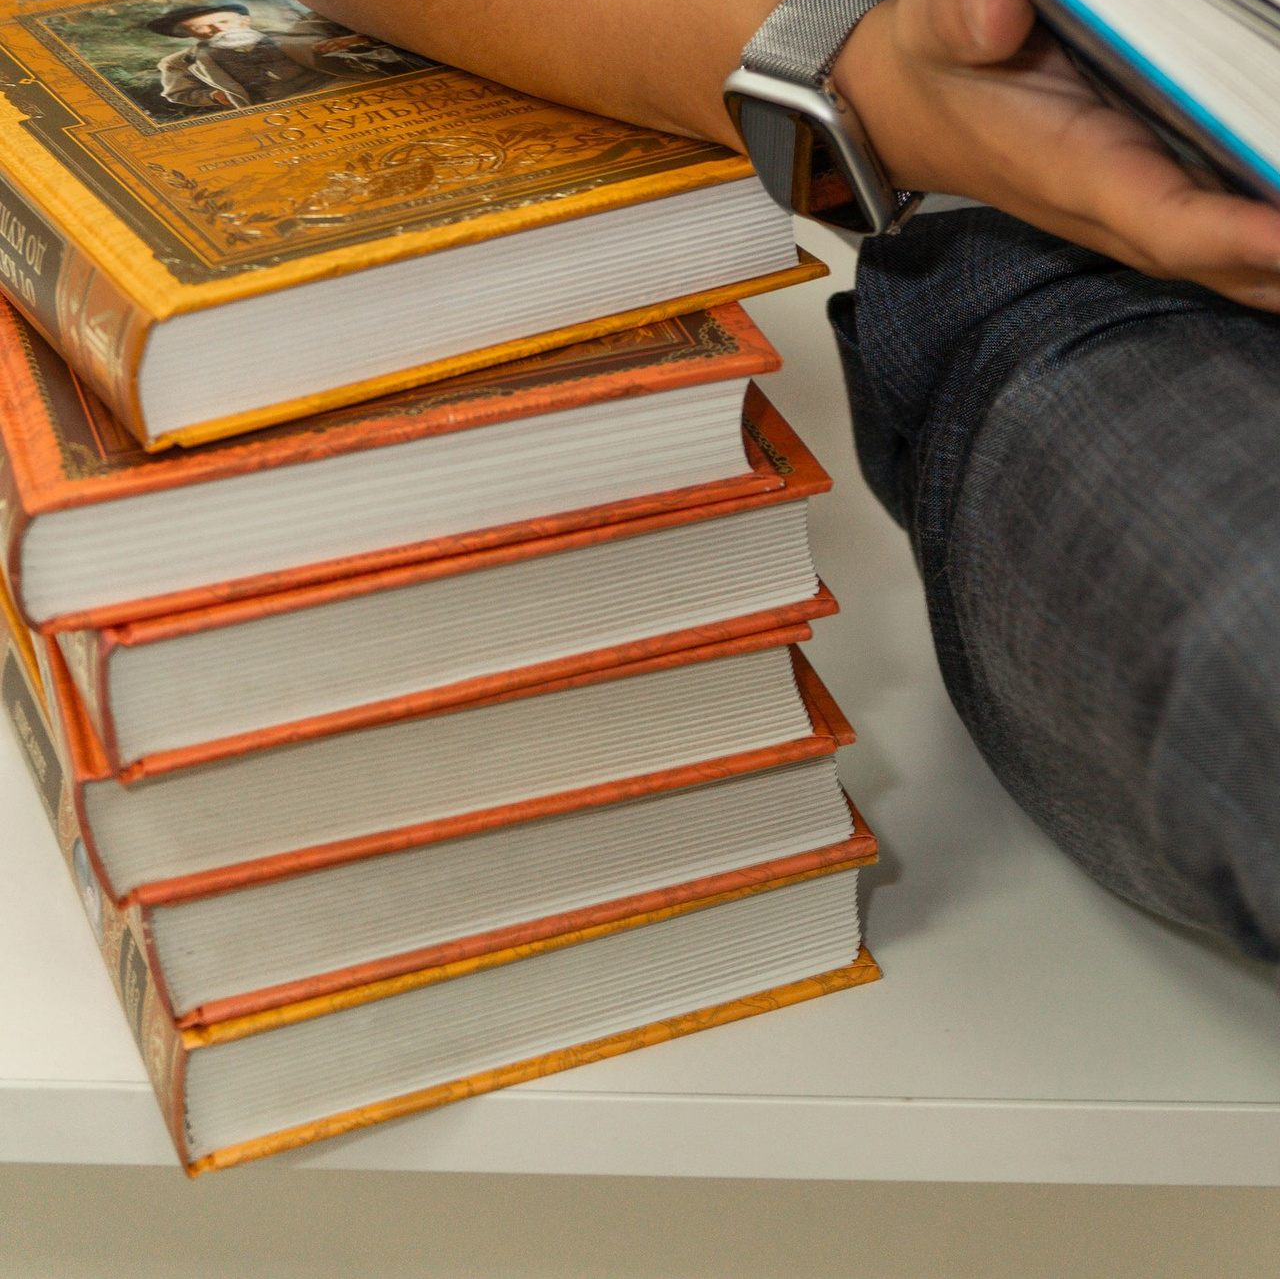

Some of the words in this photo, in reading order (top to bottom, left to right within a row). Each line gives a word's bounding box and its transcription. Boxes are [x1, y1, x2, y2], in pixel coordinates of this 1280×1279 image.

[254, 127, 306, 150] ДО
[313, 85, 498, 134] КУЛЬДЖИ
[263, 107, 315, 126] ОТ
[321, 77, 456, 114] КЯХТЫ
[338, 110, 461, 140] ЦЕНТРАЛЬНУЮ
[464, 99, 510, 114] АЗИЮ
[317, 125, 440, 159] ПУТЕШЕСТВИЯ
[442, 120, 466, 131] ПО
[469, 104, 535, 125] СИБИРИ
